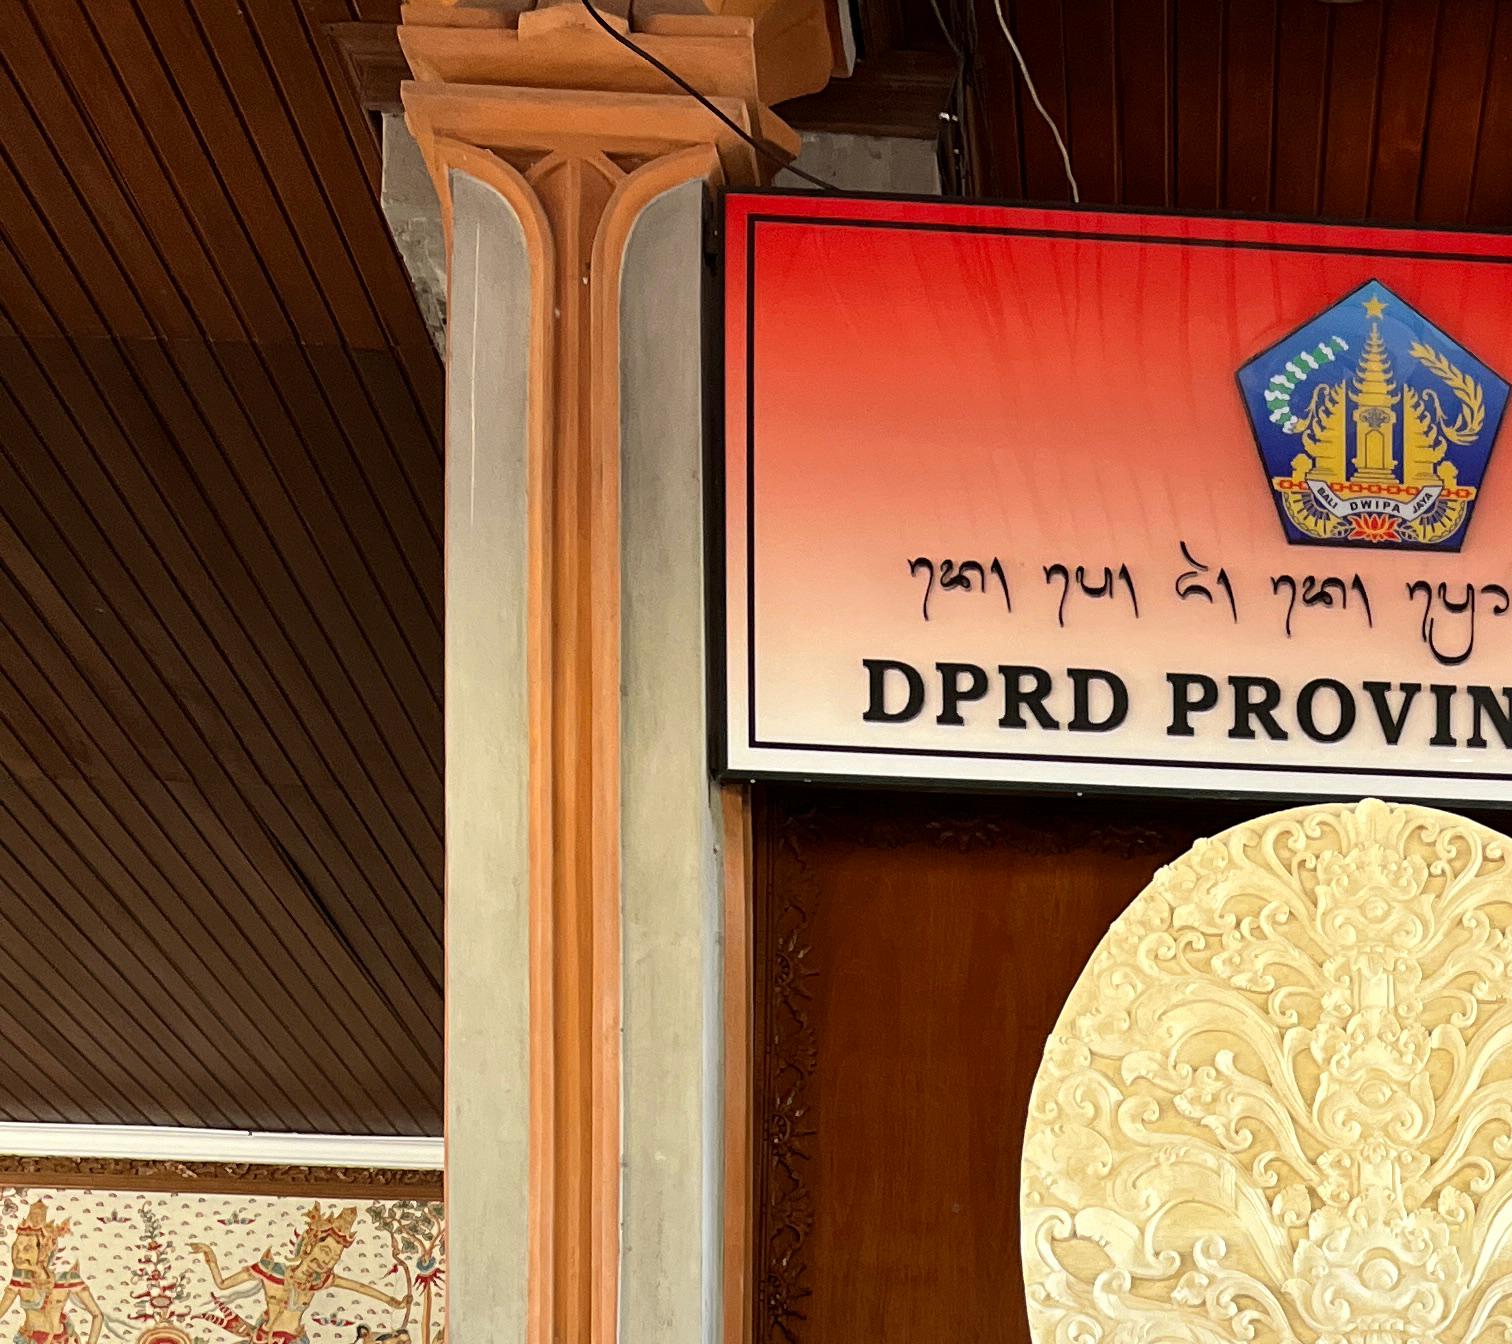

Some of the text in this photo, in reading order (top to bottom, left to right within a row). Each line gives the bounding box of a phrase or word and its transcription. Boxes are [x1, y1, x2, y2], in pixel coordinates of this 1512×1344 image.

[1317, 486, 1433, 514] BALI DWIPA JAYA
[862, 658, 1129, 733] DPRD
